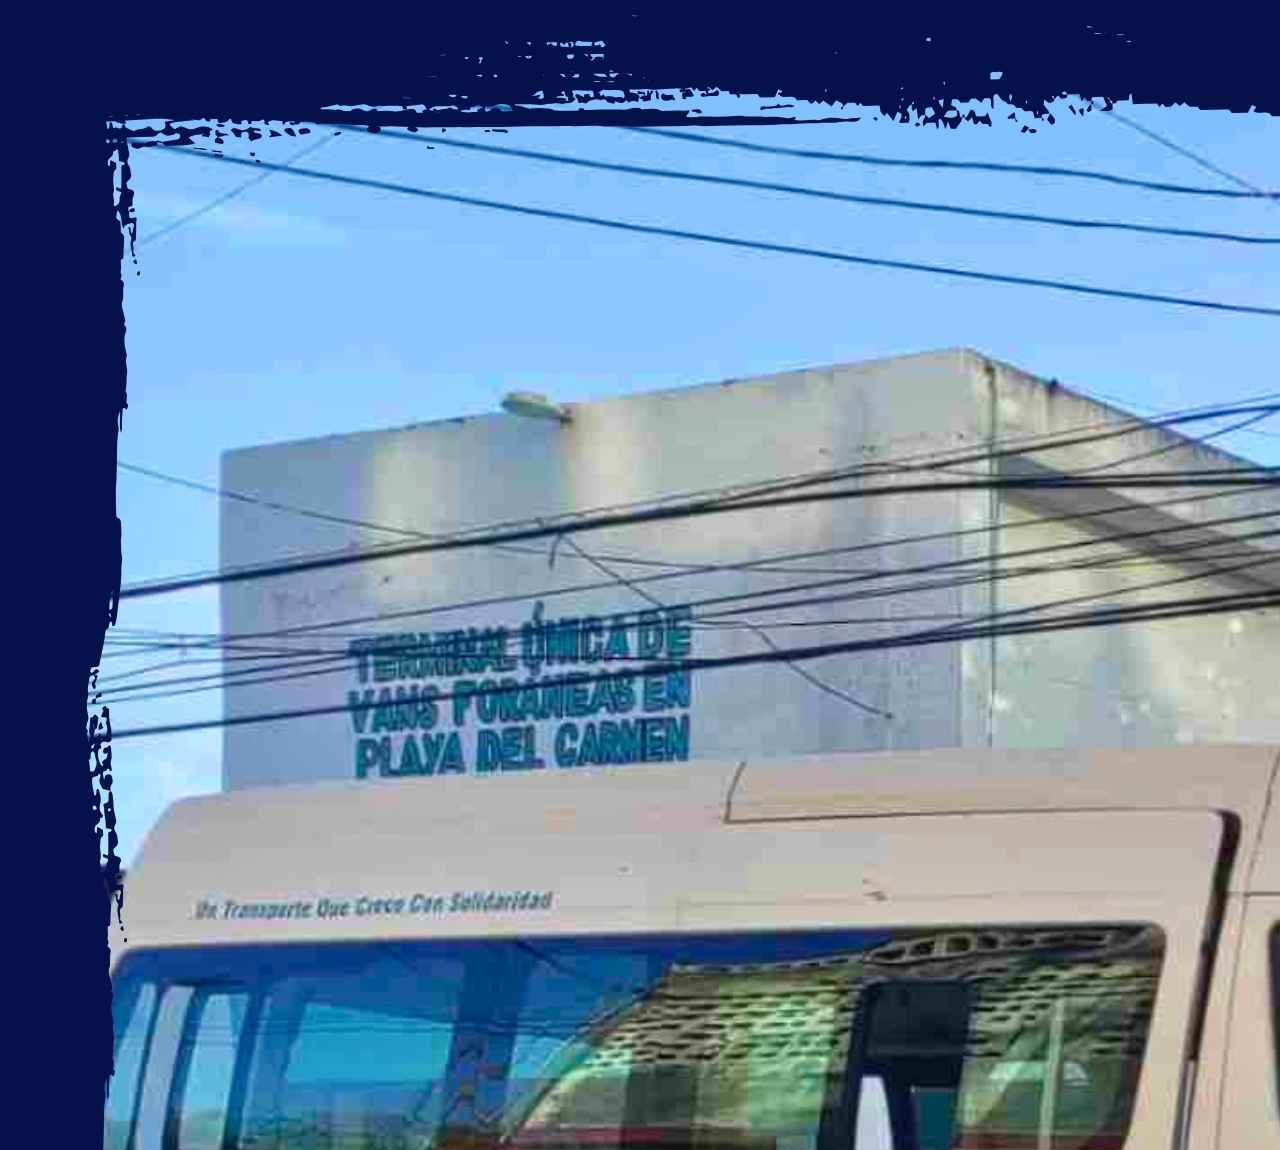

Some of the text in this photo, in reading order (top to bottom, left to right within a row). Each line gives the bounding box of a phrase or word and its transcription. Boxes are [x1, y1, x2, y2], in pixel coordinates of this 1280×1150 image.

[349, 600, 692, 683] TERMINAL ÚNICA DE
[349, 684, 439, 733] VANS
[643, 662, 690, 709] EN
[356, 714, 690, 779] PLAYA DEL CARMEN
[195, 900, 217, 920] Un
[223, 898, 312, 920] Transporte
[317, 898, 349, 917] Que
[409, 893, 442, 913] Con
[450, 890, 552, 911] Solidaridad
